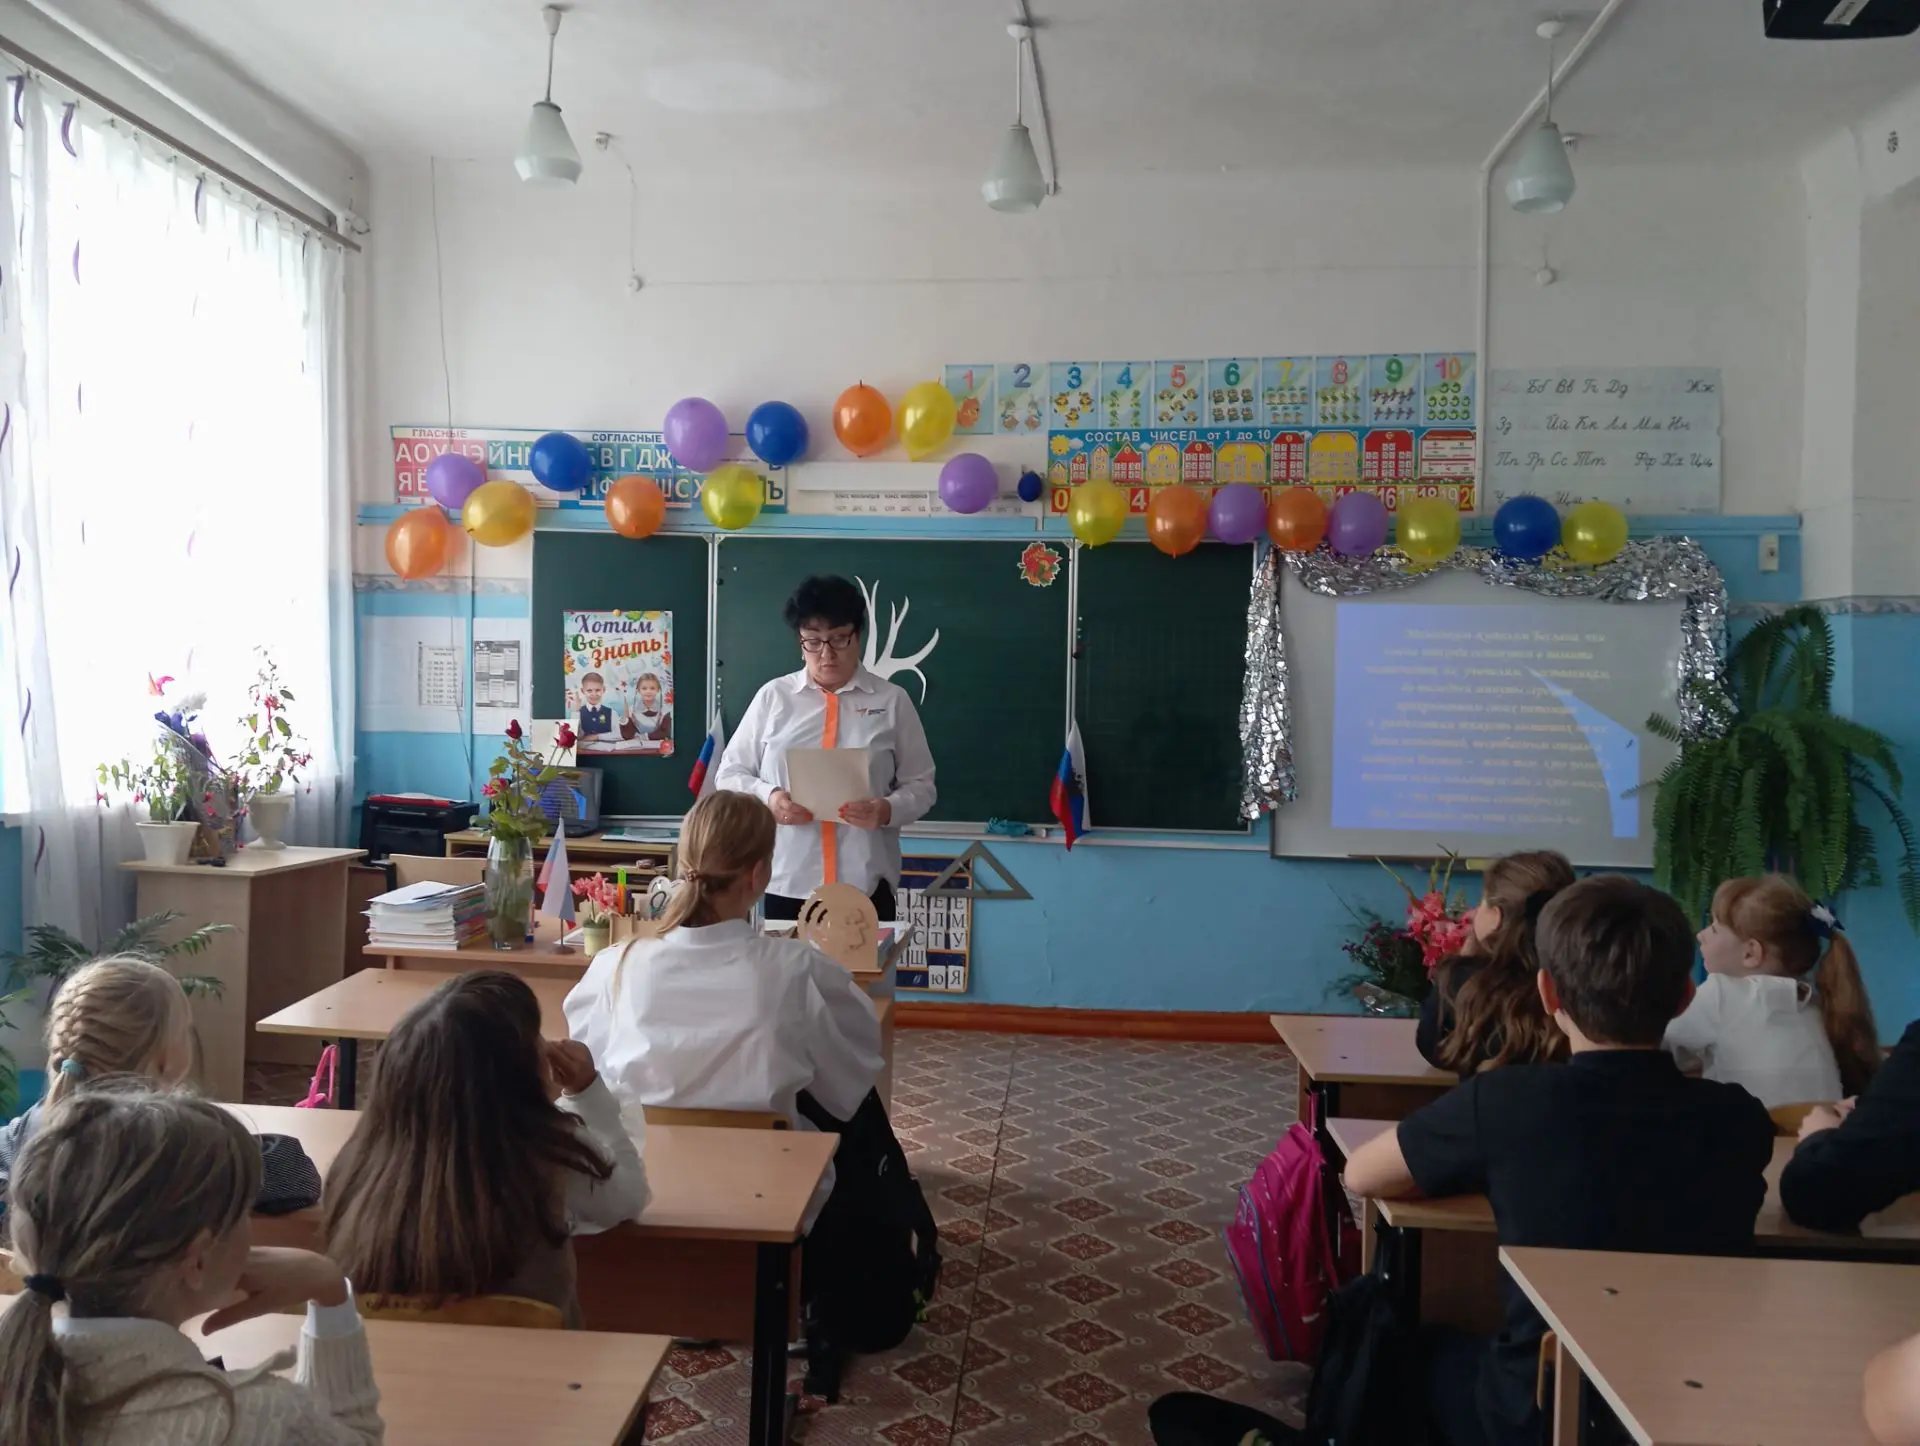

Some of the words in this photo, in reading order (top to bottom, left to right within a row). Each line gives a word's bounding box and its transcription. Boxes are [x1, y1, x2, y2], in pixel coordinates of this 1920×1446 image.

[1013, 363, 1031, 388] 2
[1067, 367, 1082, 390] 3
[1117, 366, 1133, 389] 4
[1171, 365, 1186, 388] 5
[1224, 362, 1240, 386] 6
[1280, 361, 1294, 385] 7
[1332, 360, 1348, 385] 8
[1385, 357, 1404, 382] 9
[1435, 356, 1461, 380] 10
[962, 369, 974, 390] 1
[412, 429, 468, 439] ГЛАСНЫЕ
[592, 433, 663, 443] СОГЛАСНЫЕ
[1085, 431, 1141, 443] СОСТАВ
[1150, 431, 1197, 441] ЧИСЕЛ
[1208, 431, 1221, 441] от
[1226, 431, 1231, 441] 1
[1236, 430, 1254, 443] до
[1257, 429, 1271, 441] 10
[1054, 488, 1068, 510] 0
[1132, 489, 1146, 510] 4
[574, 614, 654, 634] Хотим
[913, 912, 925, 927] К
[932, 912, 944, 928] Л
[951, 913, 965, 929] М
[913, 931, 925, 946] С
[931, 931, 942, 947] Т
[953, 932, 965, 948] У
[910, 949, 924, 965] Ш
[950, 970, 961, 986] Я
